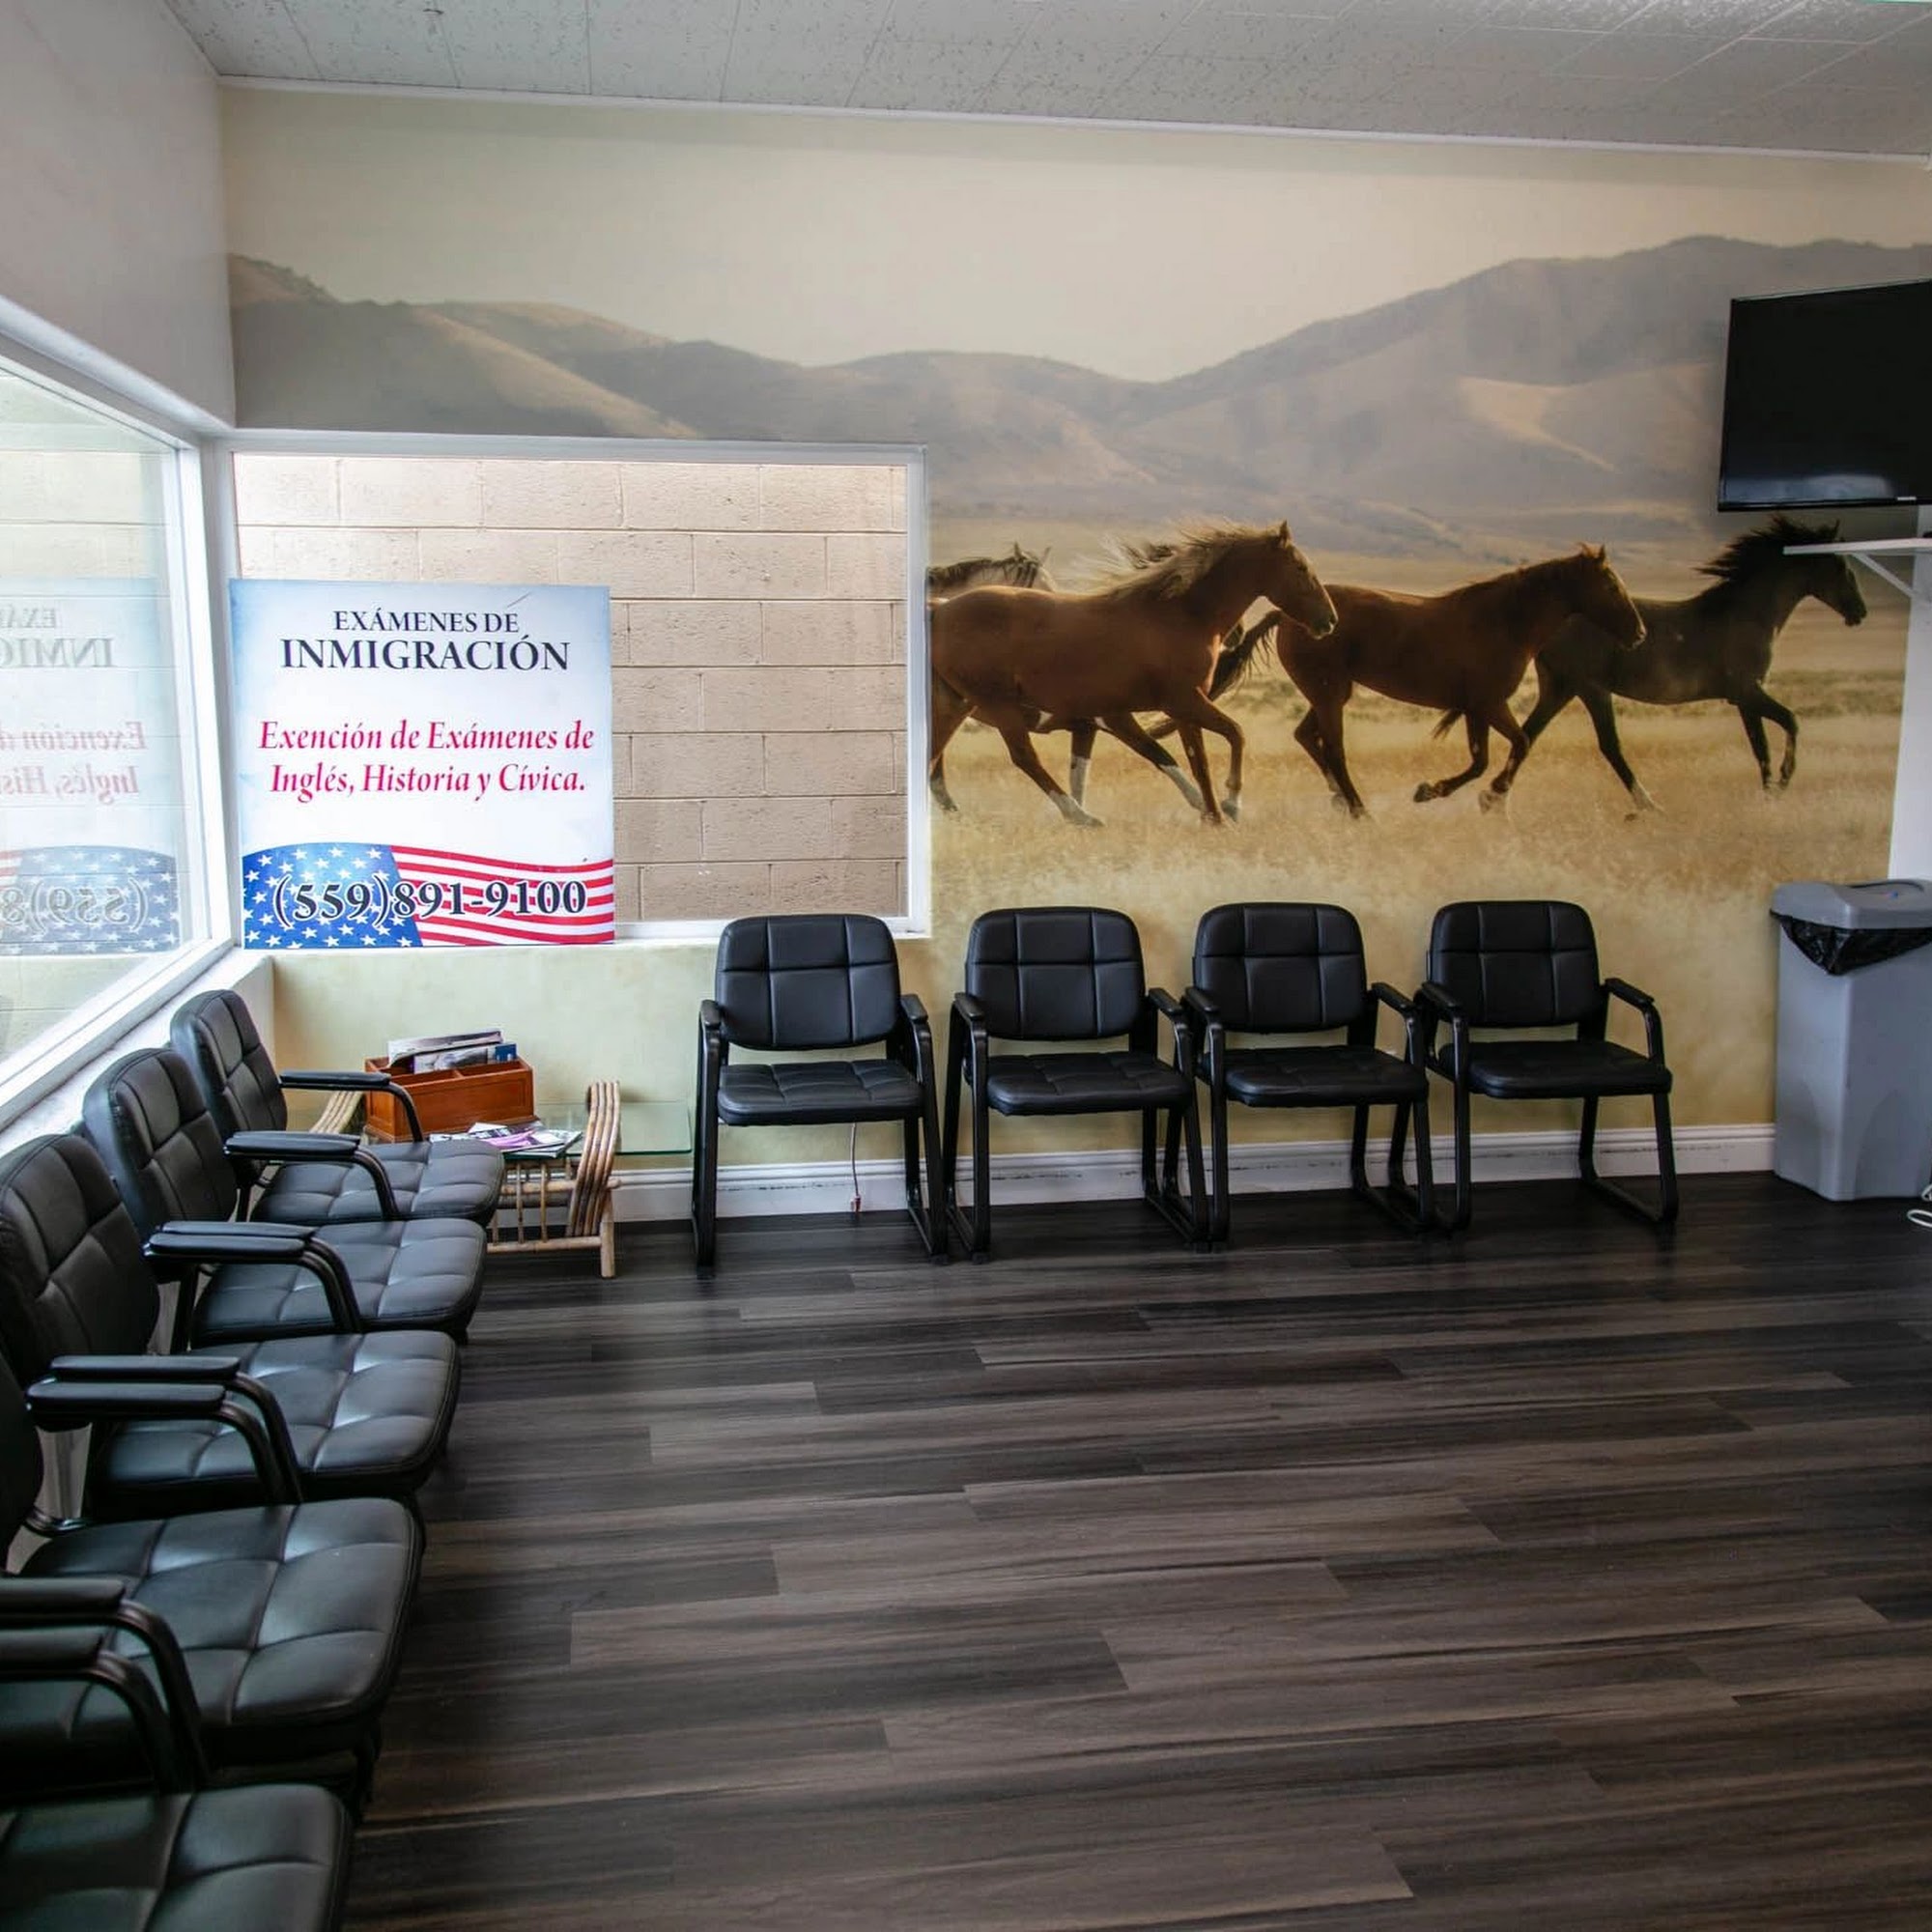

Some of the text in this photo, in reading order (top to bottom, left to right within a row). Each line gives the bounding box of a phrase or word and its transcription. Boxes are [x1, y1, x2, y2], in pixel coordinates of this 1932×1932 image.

[333, 607, 519, 633] EXÁMENES DE
[280, 635, 571, 671] INMIGRACIÓN
[259, 719, 593, 750] Exención de Exámenes de
[270, 761, 585, 803] Inglés, Historia y Cívica.
[272, 873, 587, 928] (559)891-9100
